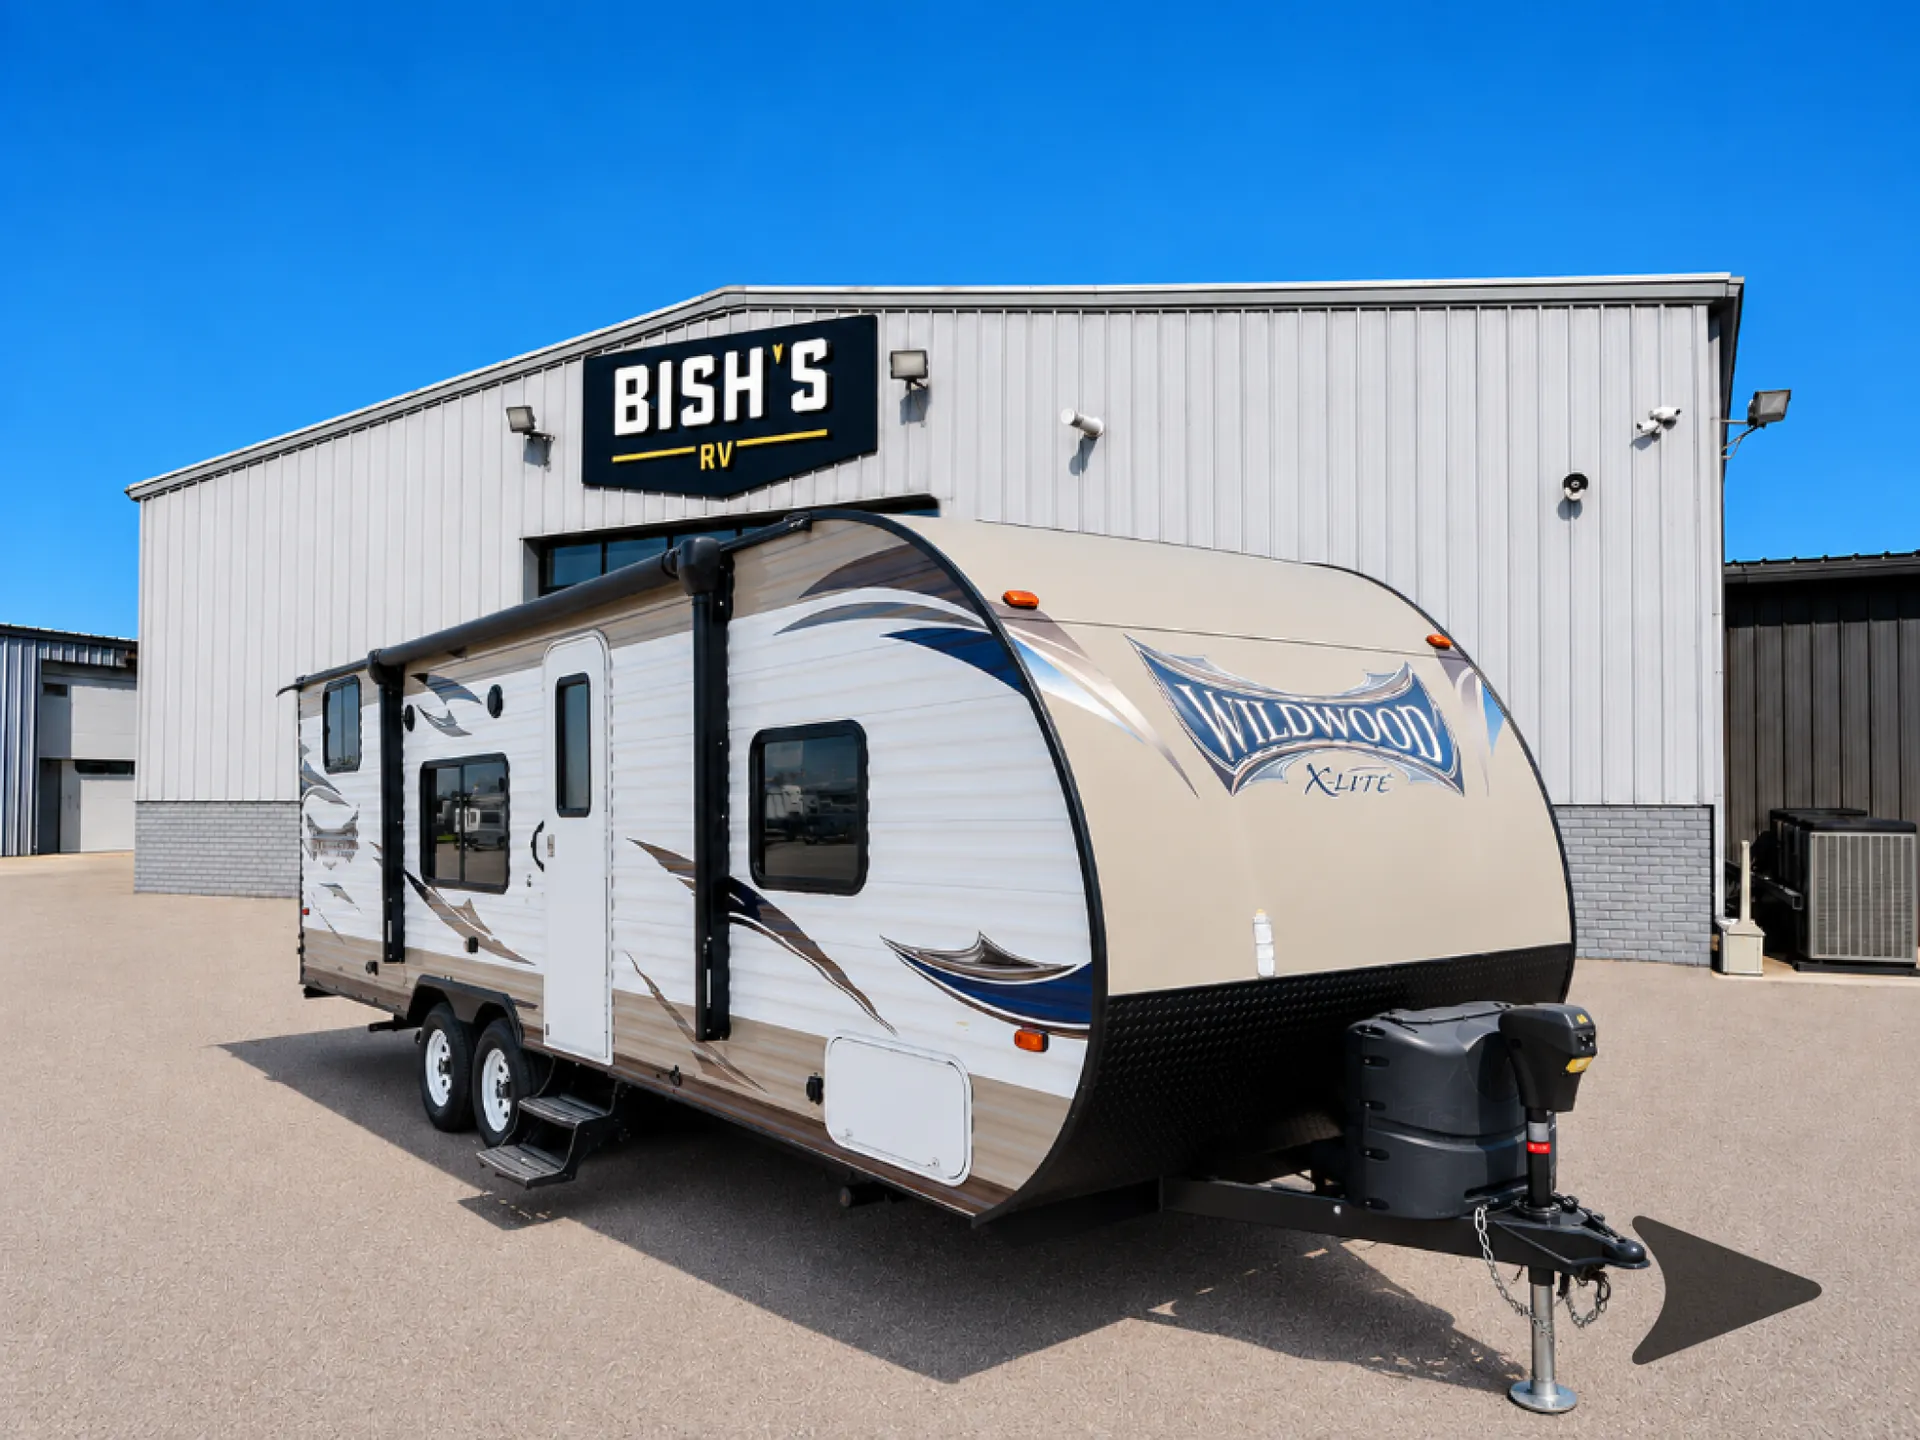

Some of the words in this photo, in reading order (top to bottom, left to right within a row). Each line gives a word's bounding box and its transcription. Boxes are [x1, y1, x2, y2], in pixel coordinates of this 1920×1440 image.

[614, 338, 828, 436] BISH'S
[700, 440, 733, 470] RV
[1176, 684, 1443, 763] WILDWOOD
[1304, 763, 1394, 797] X-LITE
